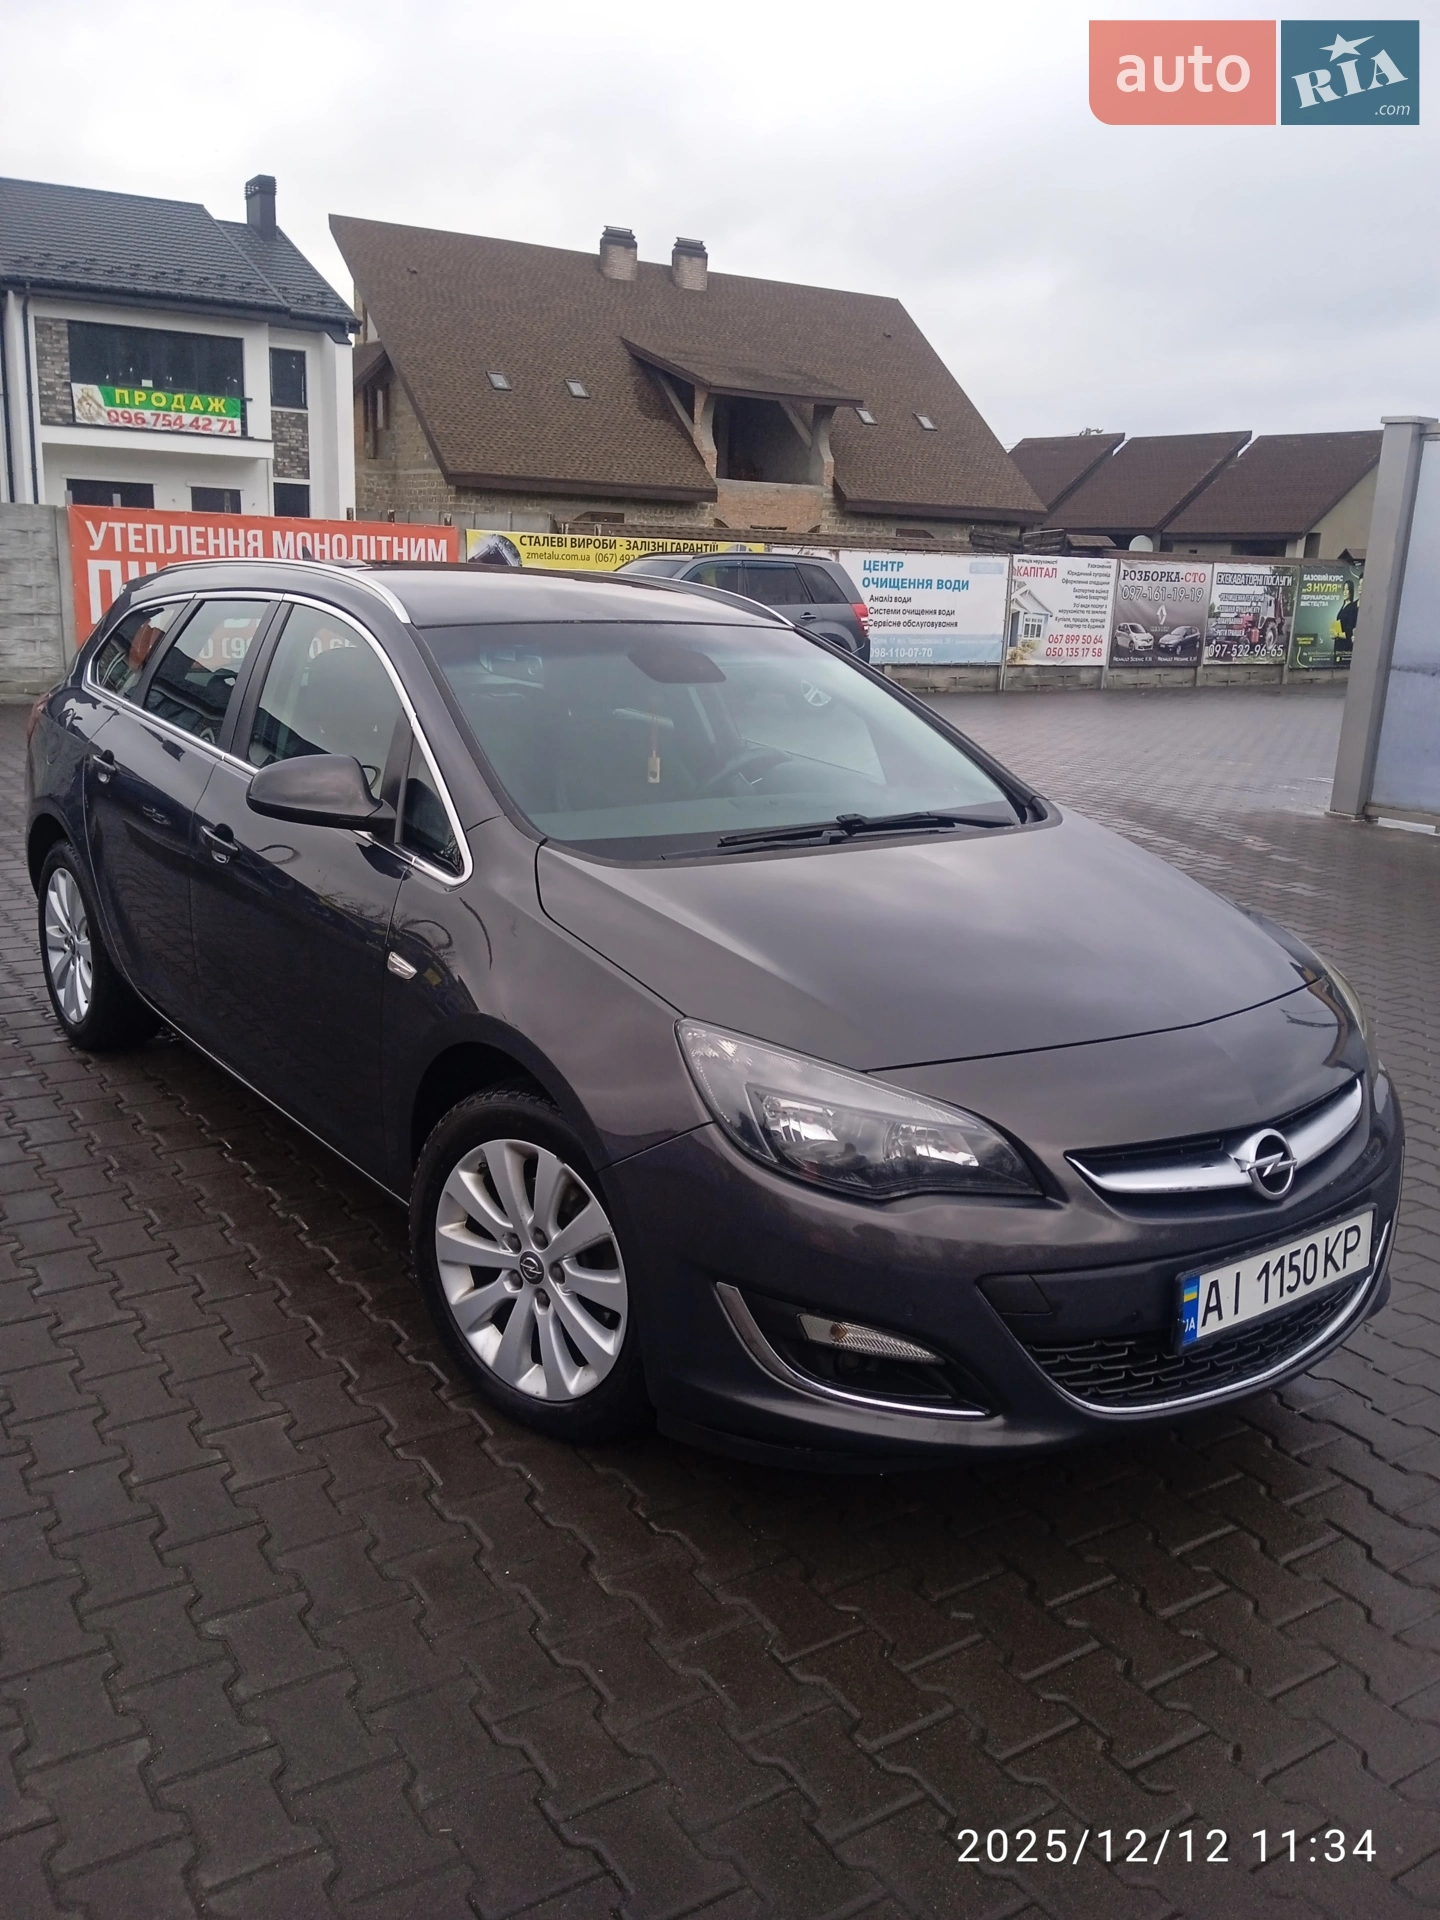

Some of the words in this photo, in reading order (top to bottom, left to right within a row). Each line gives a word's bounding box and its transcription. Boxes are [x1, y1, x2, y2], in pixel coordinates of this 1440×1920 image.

[115, 388, 226, 414] ПРОДАЖ
[107, 409, 146, 426] 096
[151, 413, 185, 430] 754
[189, 416, 213, 432] 42
[216, 418, 237, 434] 71
[85, 520, 264, 558] УТЕПЛЕННЯ
[272, 530, 448, 562] МОНОЛІТНИМ
[519, 535, 567, 548] СТАЛЕВІ
[570, 537, 617, 550] ВИРОБИ
[625, 540, 668, 552] ЗАЛІЗНІ
[526, 551, 591, 562] zmetalu.com.ua
[595, 552, 618, 564] (067)
[863, 560, 904, 573] ЦЕНТР
[1016, 566, 1058, 579] КАПІТАЛ
[1122, 569, 1206, 583] РОЗБОРКА-СТО
[1263, 574, 1293, 586] ПОСЛУГИ
[1303, 573, 1328, 581] БАЗОВИЙ
[1328, 574, 1344, 582] КУРС
[862, 577, 933, 591] ОЧИЩЕННЯ
[936, 579, 969, 592] ВОДИ
[869, 594, 893, 603] Аналіз
[894, 596, 912, 604] води
[1122, 585, 1204, 602] 097-161-19-19
[868, 607, 901, 615] Системи
[938, 609, 956, 617] води
[868, 619, 901, 629] Сервісне
[902, 619, 958, 629] обслуговування
[1048, 634, 1064, 644] 067
[1064, 634, 1080, 645] 899
[1081, 634, 1092, 645] 50
[1092, 634, 1103, 645] 64
[1045, 647, 1064, 657] 050
[1066, 647, 1079, 657] 135
[1081, 647, 1090, 657] 17
[1091, 647, 1103, 658] 58
[1208, 644, 1284, 658] 097-522-96-65
[1200, 1271, 1241, 1328] AI
